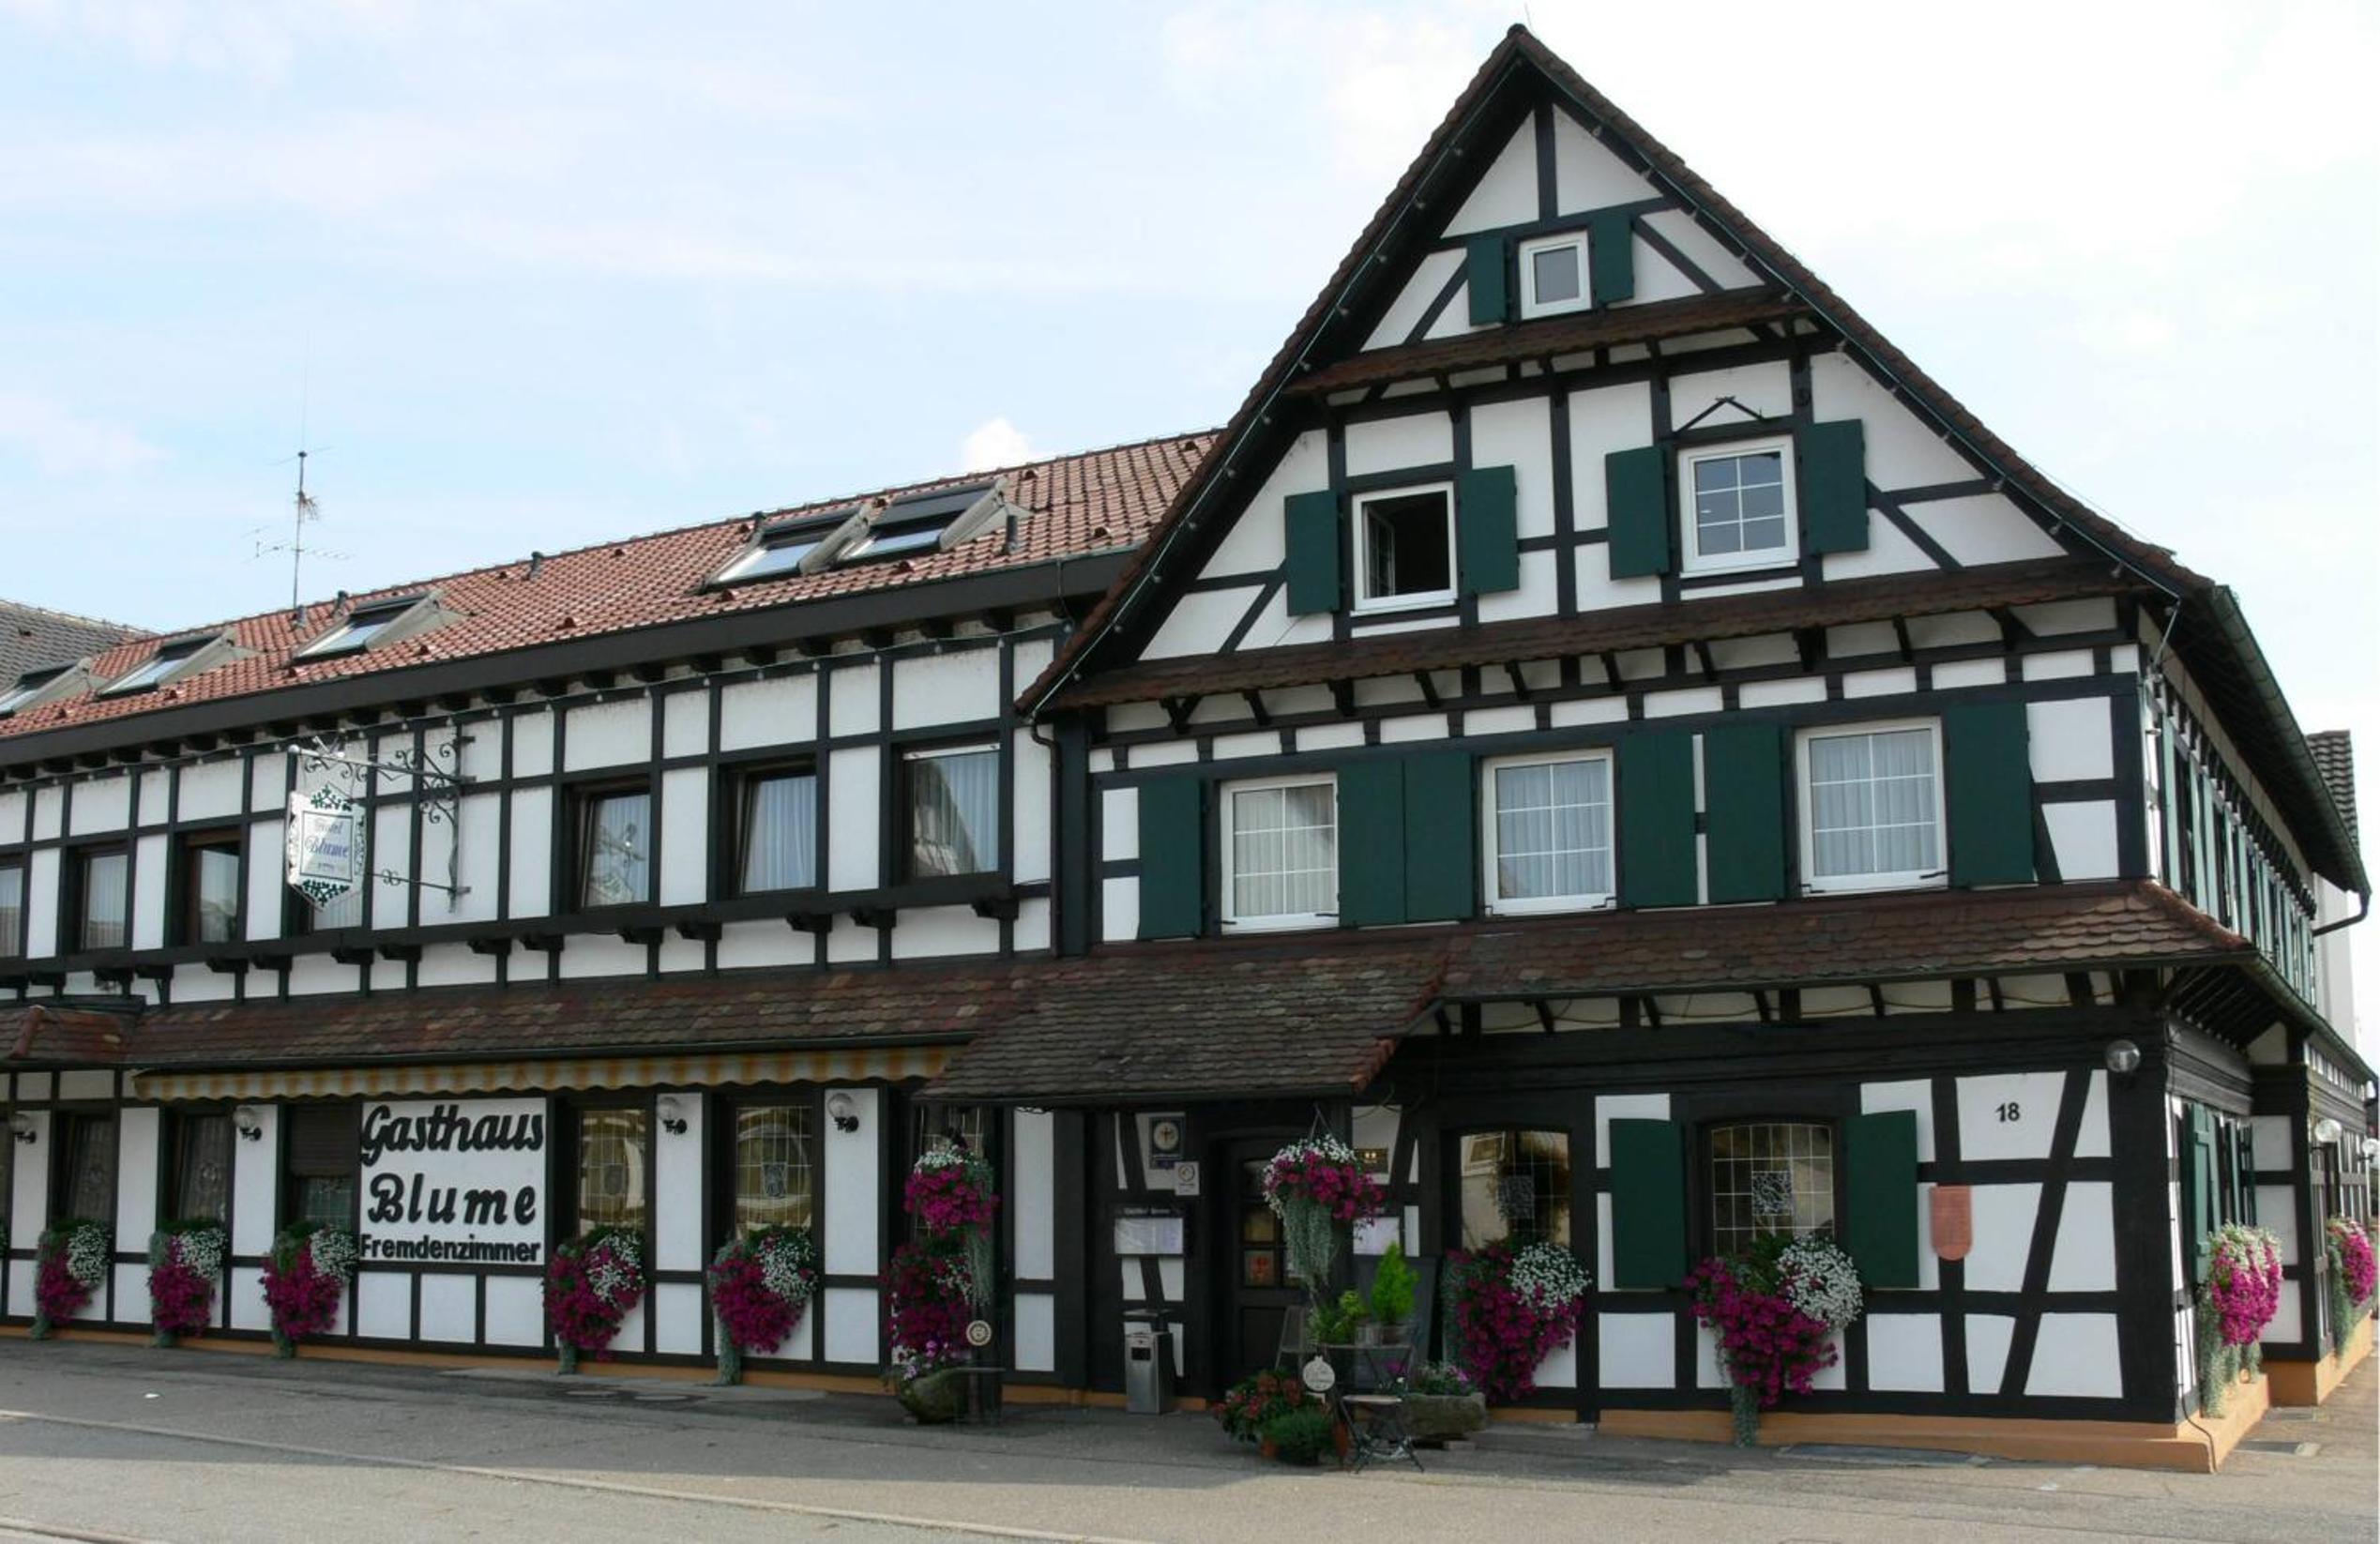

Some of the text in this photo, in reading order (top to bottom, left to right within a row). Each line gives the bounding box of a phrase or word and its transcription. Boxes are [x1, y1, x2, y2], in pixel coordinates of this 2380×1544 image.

[305, 835, 350, 857] Blume
[1995, 1101, 2020, 1122] 18
[359, 1104, 544, 1167] Gasthaus
[368, 1173, 537, 1225] Blume
[360, 1234, 541, 1262] Fremdenzimmer
